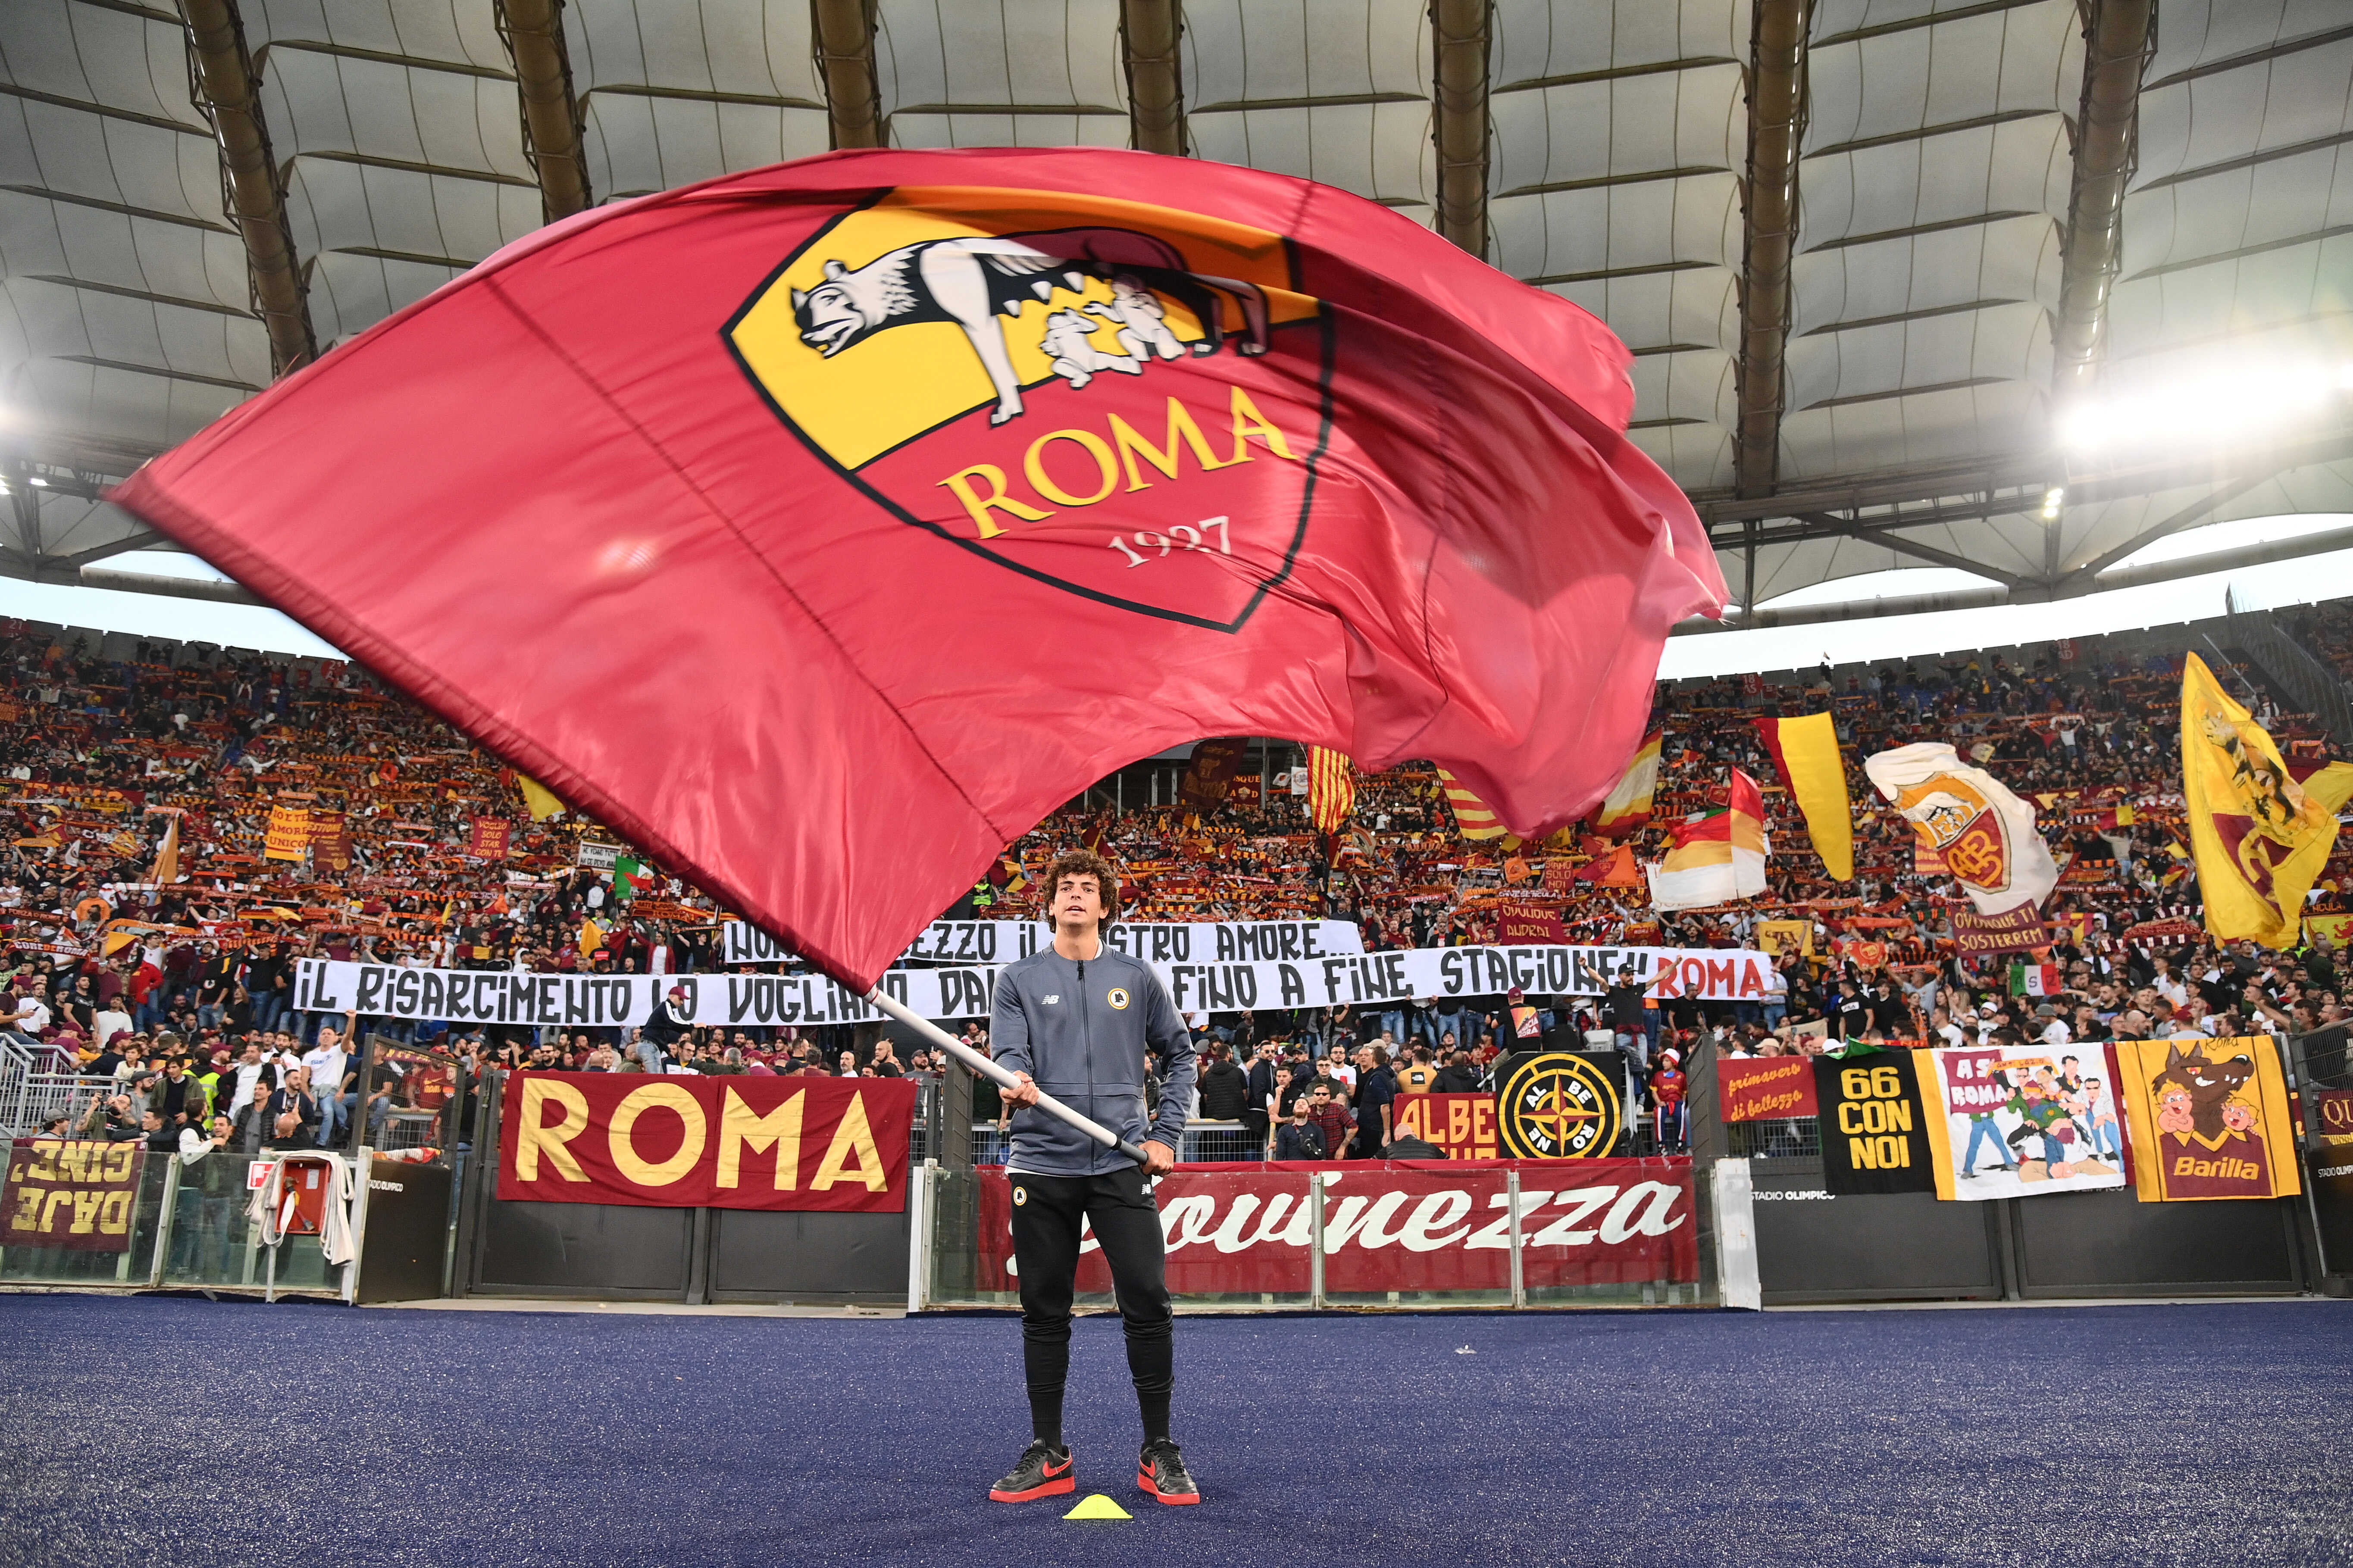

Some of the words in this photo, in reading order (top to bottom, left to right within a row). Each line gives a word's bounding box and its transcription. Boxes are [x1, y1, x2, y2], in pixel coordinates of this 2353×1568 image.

[936, 386, 1299, 540] ROMA
[1107, 516, 1231, 569] 1927
[270, 822, 308, 835] AMORE
[480, 831, 503, 840] SOLO
[269, 836, 305, 848] UNICO
[475, 849, 492, 857] CON
[494, 850, 503, 858] TE
[480, 840, 500, 849] STAR
[1546, 871, 1571, 880] SOLO
[1955, 912, 2019, 930] OVUNQUE
[2019, 906, 2037, 923] TI
[900, 923, 996, 961] EZZO
[1101, 925, 1190, 962] STRO
[1959, 927, 2044, 952] SOSTERREM
[302, 962, 337, 1009] iL
[356, 966, 632, 1023] RiSARCiMENTO
[1172, 965, 1257, 1010] FiNO
[1279, 964, 1305, 1006] A
[1322, 953, 1414, 1003] FiNE
[1657, 956, 1766, 999] ROMA
[1727, 1062, 1801, 1097] primavera
[1956, 1058, 1990, 1079] AS
[1568, 1080, 1593, 1105] BE
[1840, 1066, 1901, 1099] 66
[1950, 1084, 2008, 1106] ROMA
[1526, 1085, 1547, 1108] AL
[1730, 1101, 1746, 1121] di
[1747, 1090, 1803, 1118] bellezza
[1401, 1099, 1495, 1144] ALBE
[1838, 1099, 1913, 1134] CON
[516, 1078, 889, 1192] ROMA
[1528, 1127, 1552, 1152] NE
[1572, 1124, 1595, 1149] RO
[1849, 1135, 1911, 1170] NOI
[2174, 1156, 2259, 1181] Barilla
[11, 1187, 133, 1234] DAJE
[1006, 1171, 1687, 1276] ovinezza
